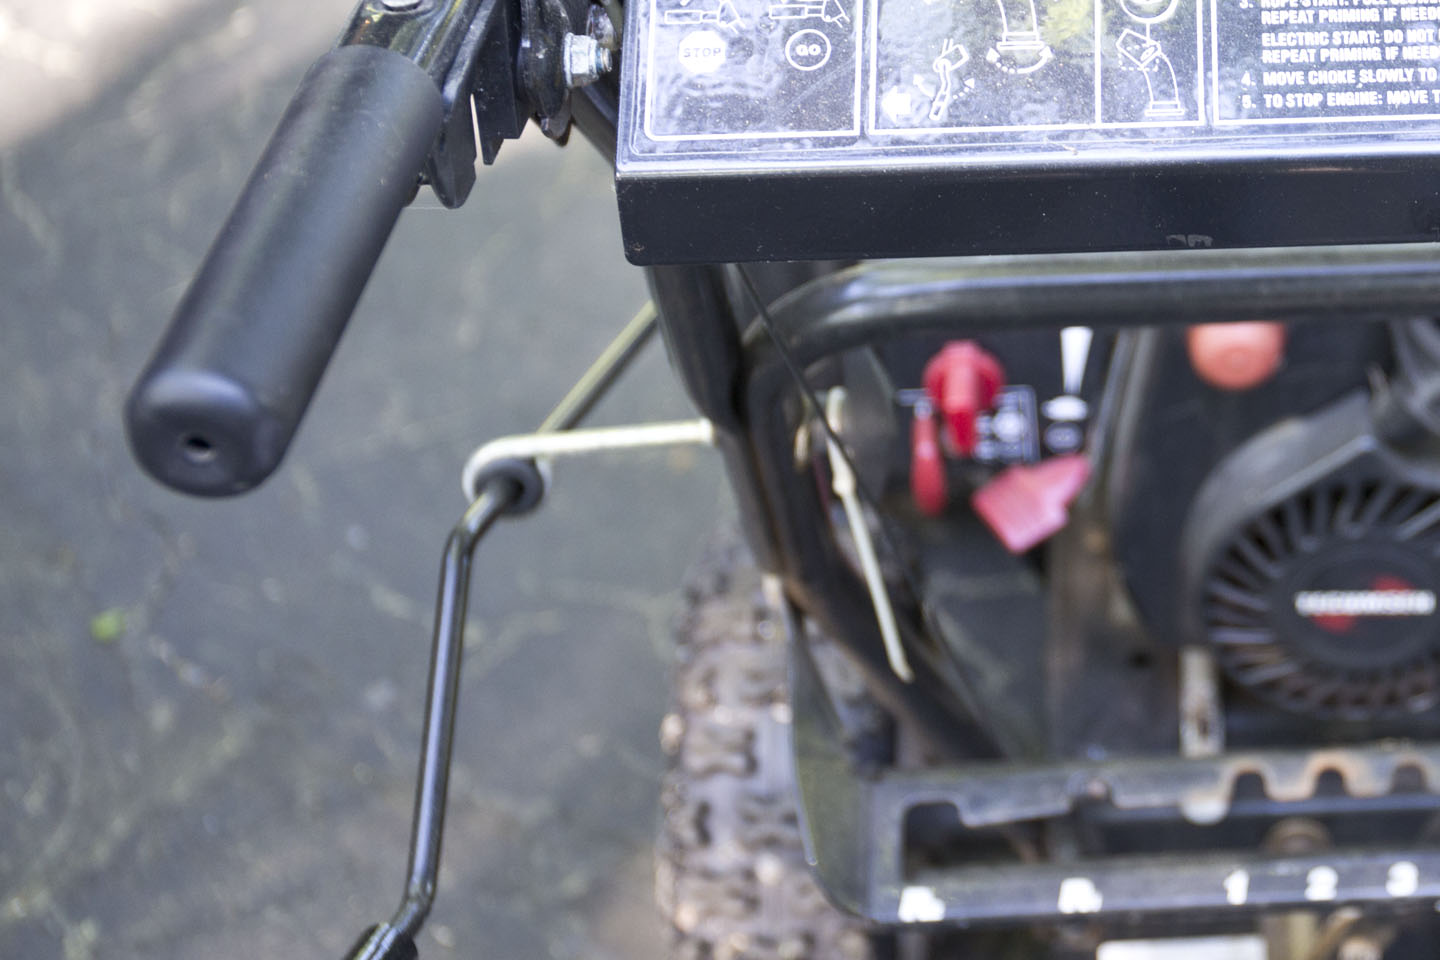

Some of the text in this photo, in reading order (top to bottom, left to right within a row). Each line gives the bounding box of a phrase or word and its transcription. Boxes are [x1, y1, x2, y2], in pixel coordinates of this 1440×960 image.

[1261, 9, 1315, 25] REPEAT
[1319, 7, 1380, 23] PRIMING
[1383, 7, 1397, 22] IF
[1261, 32, 1329, 47] ELECTRIC
[1332, 30, 1381, 45] START:
[1383, 29, 1404, 43] DO
[1406, 28, 1434, 43] NOT
[684, 47, 721, 58] STOP
[796, 44, 821, 56] GO
[1262, 48, 1316, 64] REPEAT
[1320, 47, 1382, 62] PRIMING
[1385, 46, 1399, 61] IF
[1241, 71, 1256, 86] 4.
[1263, 71, 1304, 86] MOVE
[1308, 69, 1356, 85] CHOKE
[1359, 68, 1413, 83] SLOWLY
[1419, 68, 1436, 82] TO
[1241, 95, 1256, 109] 5.
[1264, 94, 1283, 109] TO
[1286, 93, 1323, 108] STOP
[1327, 91, 1383, 107] ENGINE:
[1387, 90, 1428, 105] MOVE
[1224, 869, 1249, 905] 1
